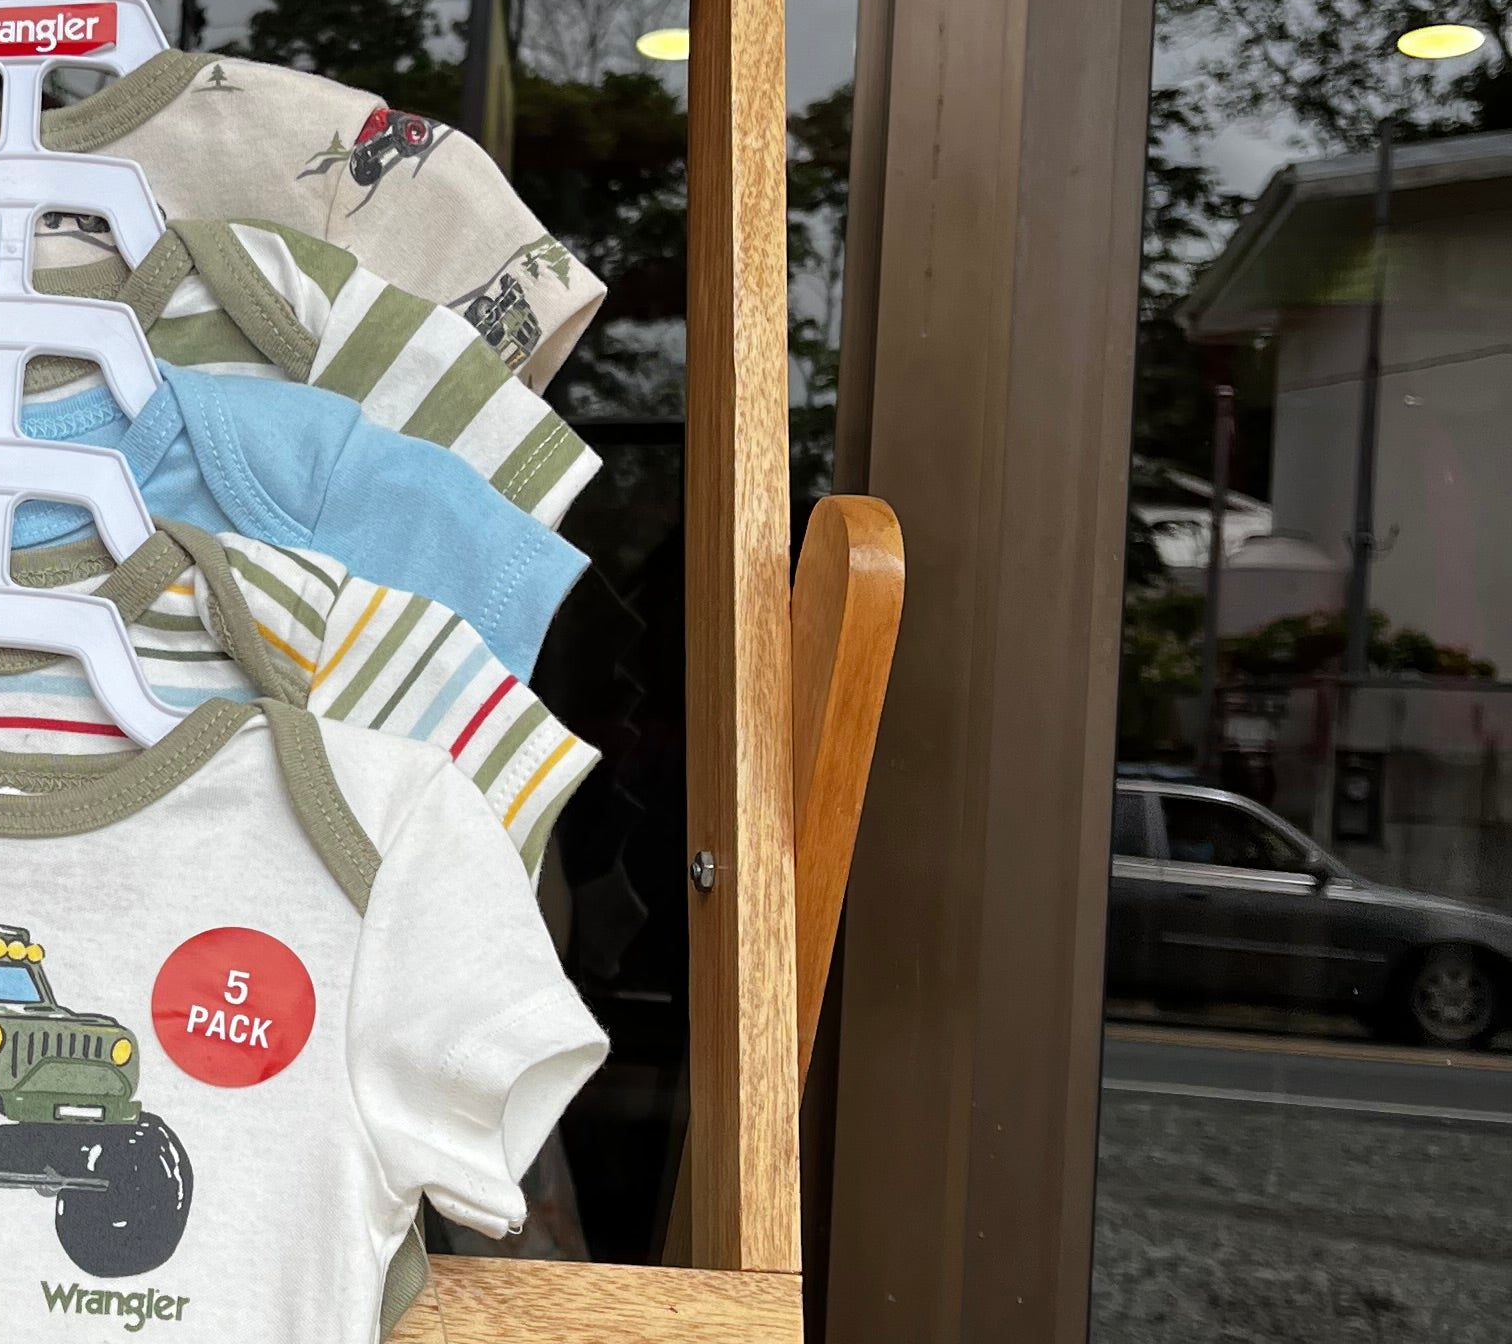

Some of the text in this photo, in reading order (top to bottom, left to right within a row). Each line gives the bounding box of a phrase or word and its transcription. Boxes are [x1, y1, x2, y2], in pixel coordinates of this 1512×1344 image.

[223, 969, 250, 1006] 5
[185, 1004, 274, 1050] PACK
[40, 1280, 191, 1333] Wrangler
